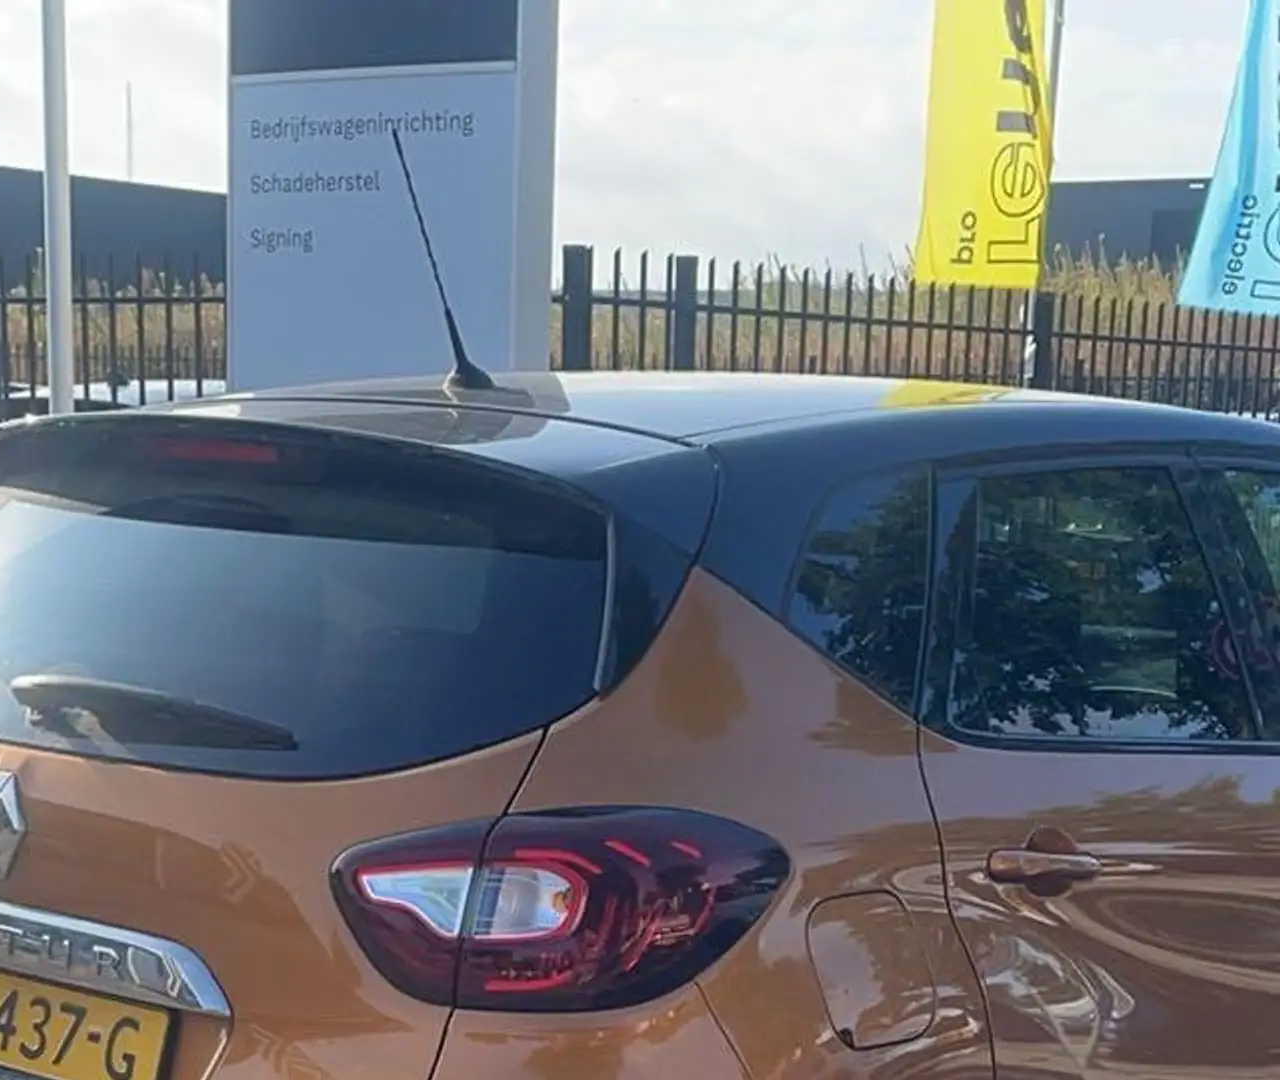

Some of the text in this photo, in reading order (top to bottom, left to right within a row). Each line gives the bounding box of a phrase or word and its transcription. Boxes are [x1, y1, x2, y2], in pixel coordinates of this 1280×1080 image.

[250, 110, 475, 143] Bedrijfswageninrichting
[250, 170, 381, 194] Schadeherstel
[250, 227, 314, 252] Signing
